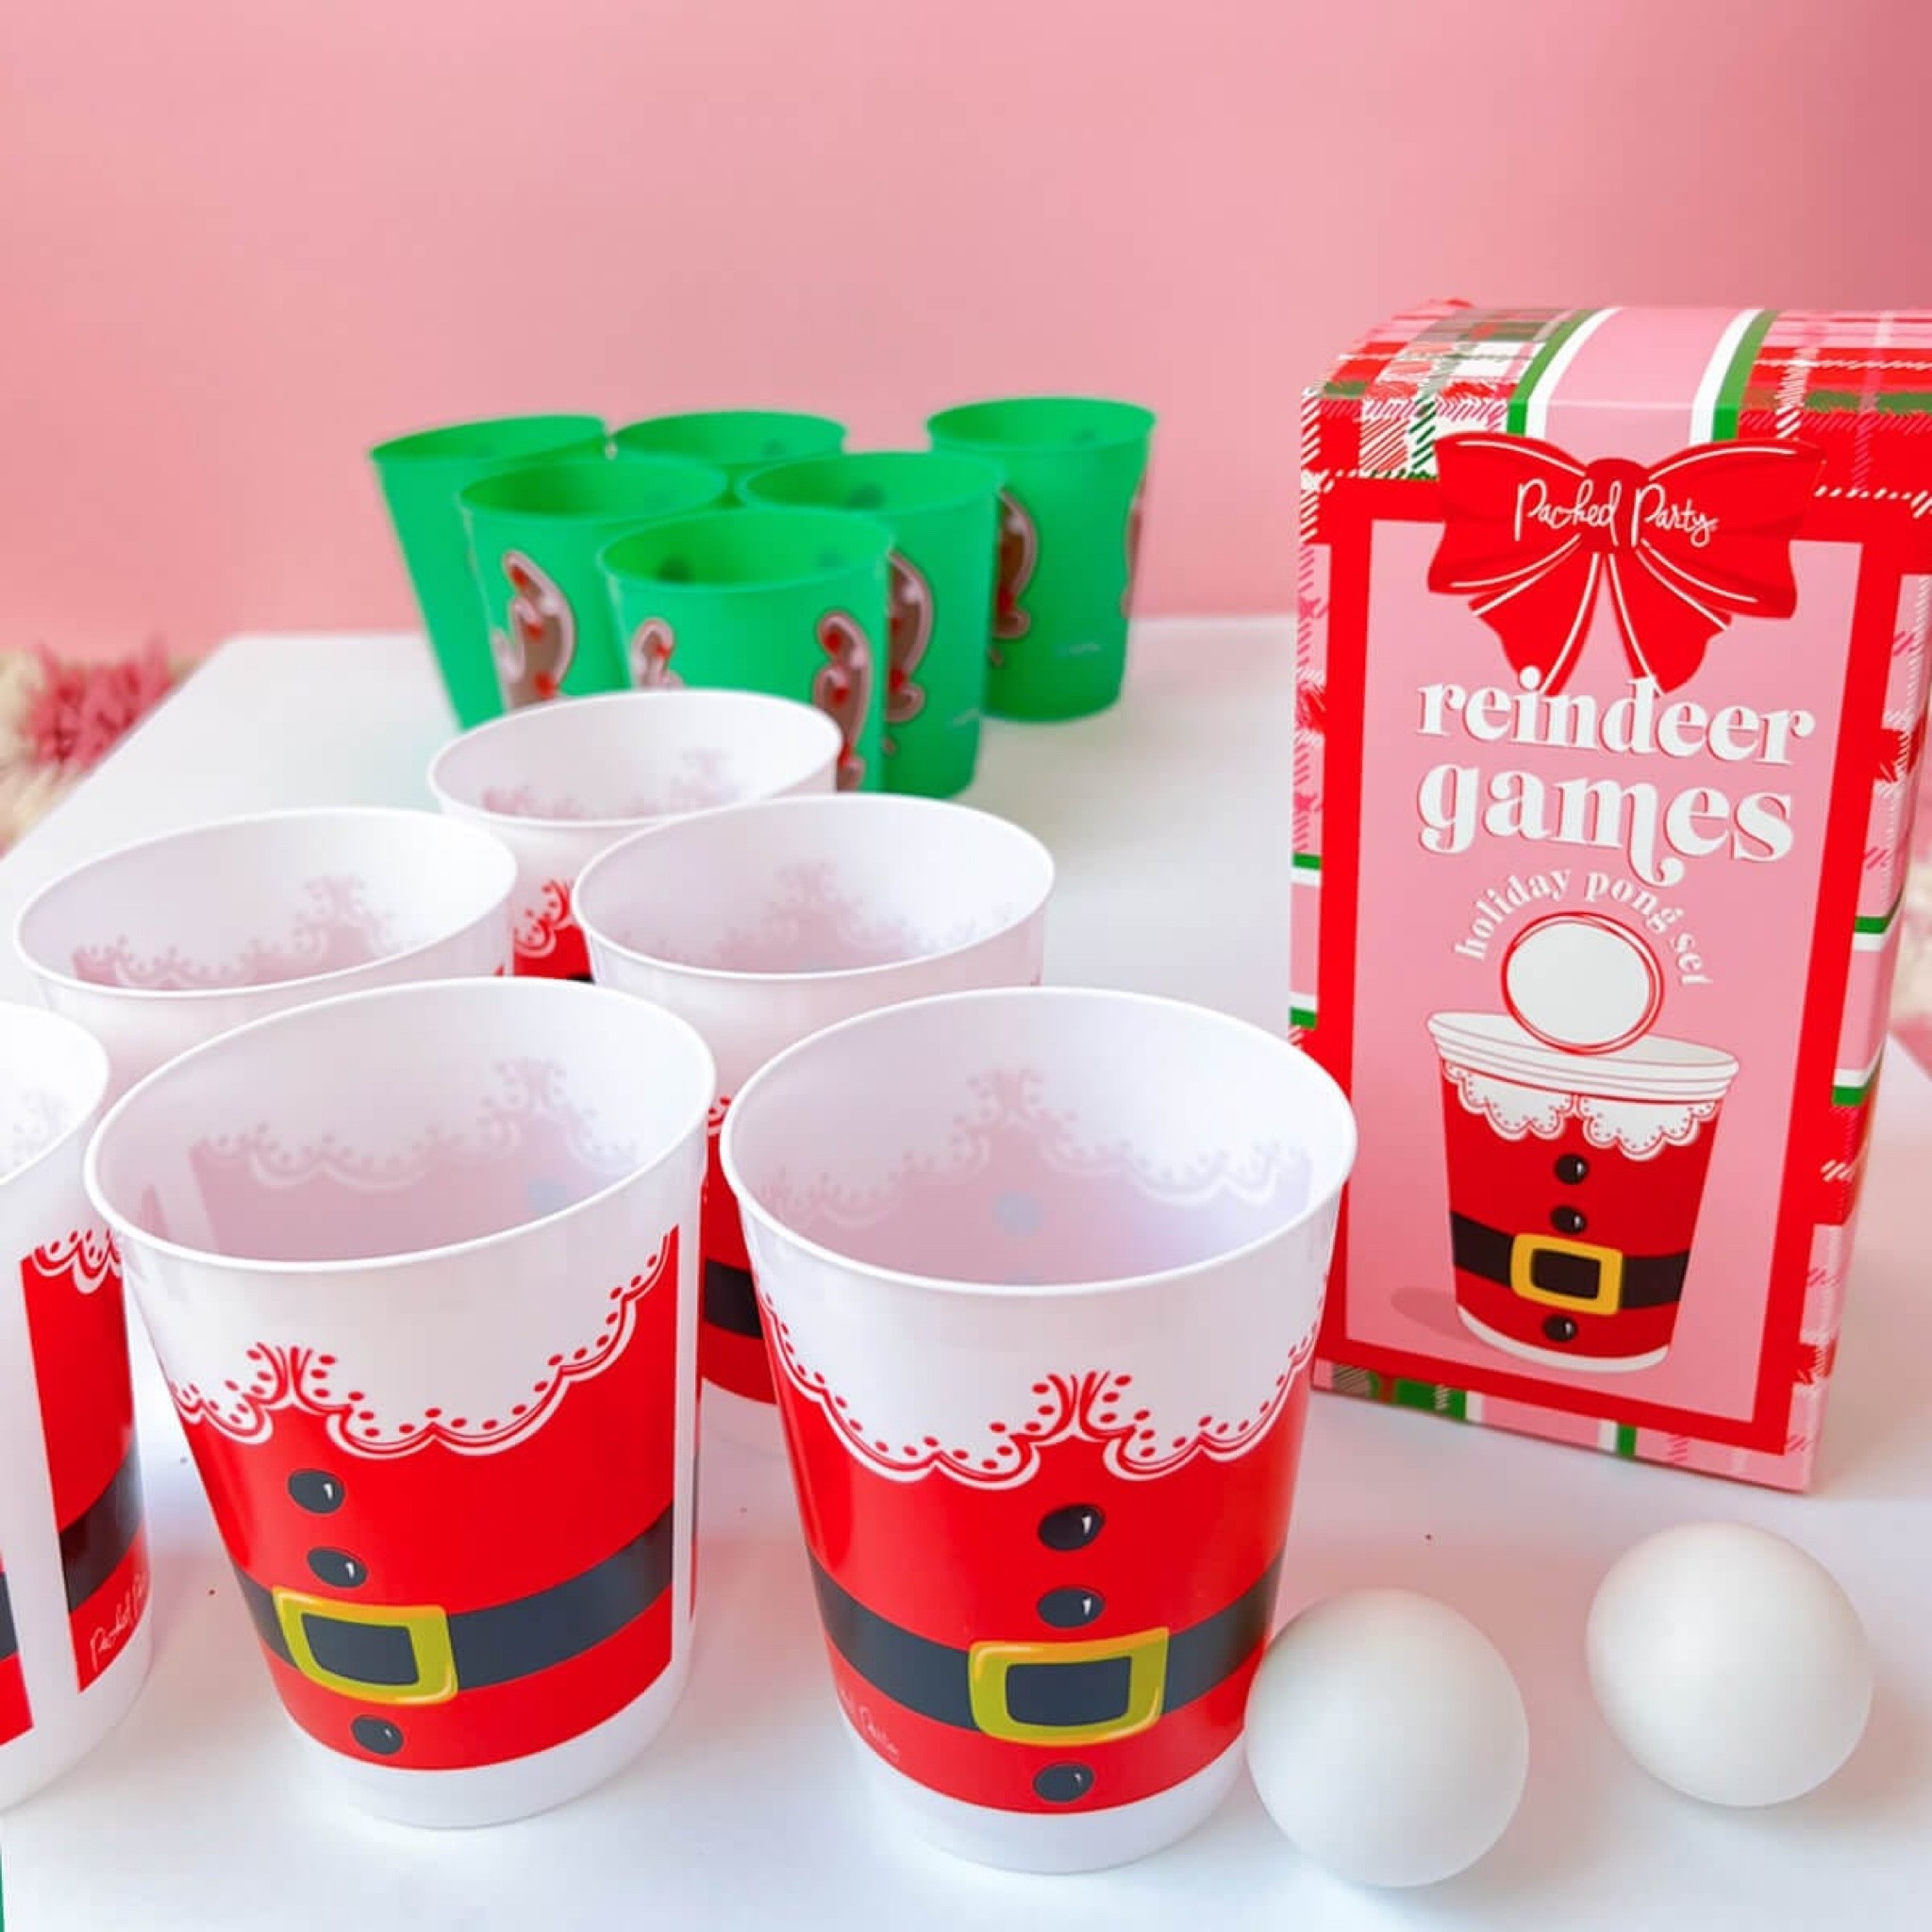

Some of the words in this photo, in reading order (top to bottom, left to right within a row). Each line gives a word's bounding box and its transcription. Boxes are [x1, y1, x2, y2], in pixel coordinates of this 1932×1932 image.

[1514, 478, 1622, 546] Packed
[1630, 482, 1719, 548] Party
[1416, 665, 1816, 766] reindeer
[1416, 762, 1794, 887] games
[1454, 868, 1572, 961] holiday
[1585, 872, 1684, 934] pong
[1667, 929, 1713, 987] set
